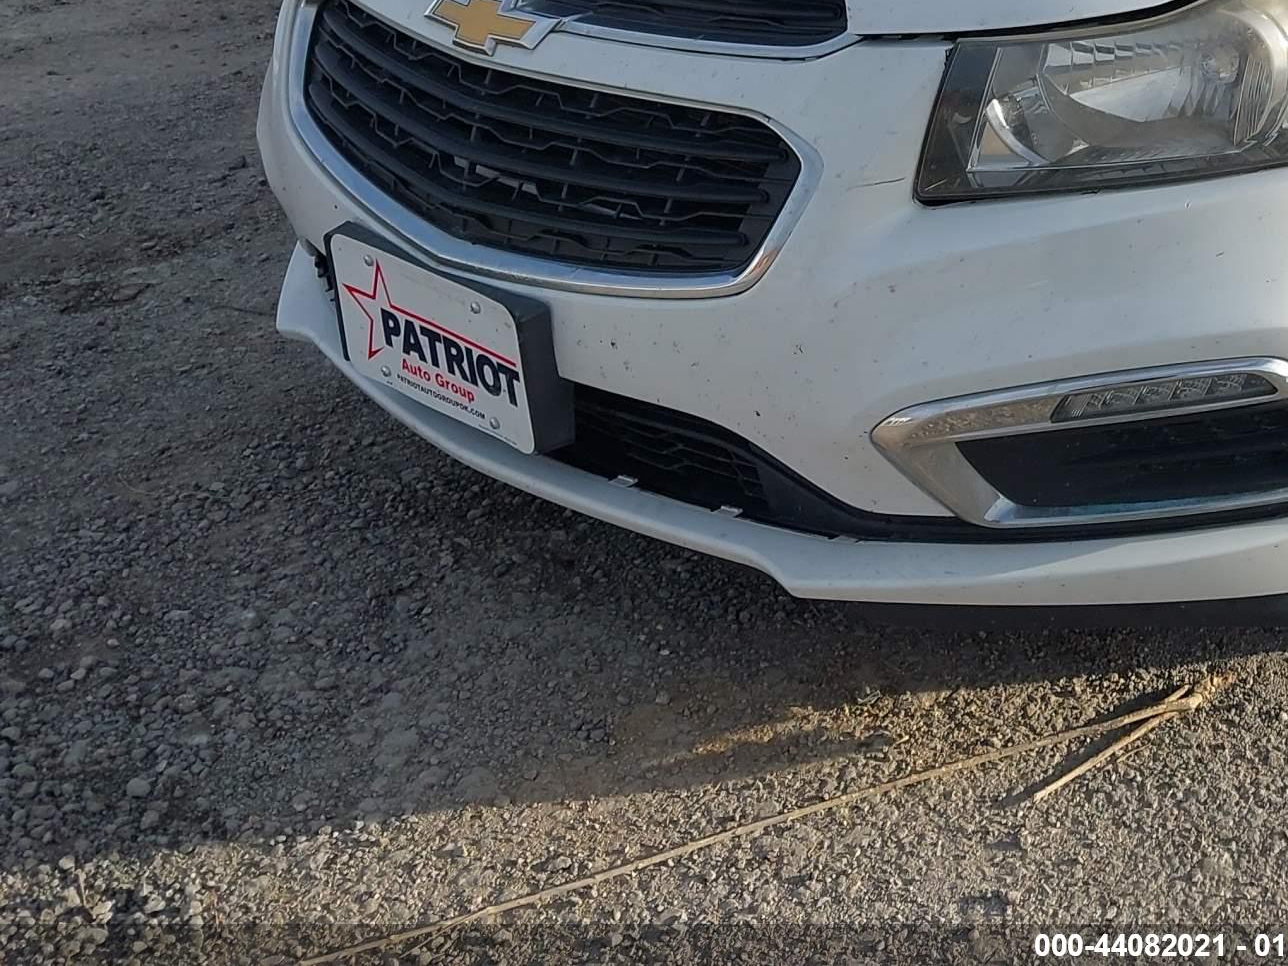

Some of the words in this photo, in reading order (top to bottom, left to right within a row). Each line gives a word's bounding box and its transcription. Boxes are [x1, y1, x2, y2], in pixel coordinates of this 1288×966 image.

[380, 307, 521, 408] PATRIOT
[402, 358, 431, 382] Auto
[435, 372, 476, 404] Group
